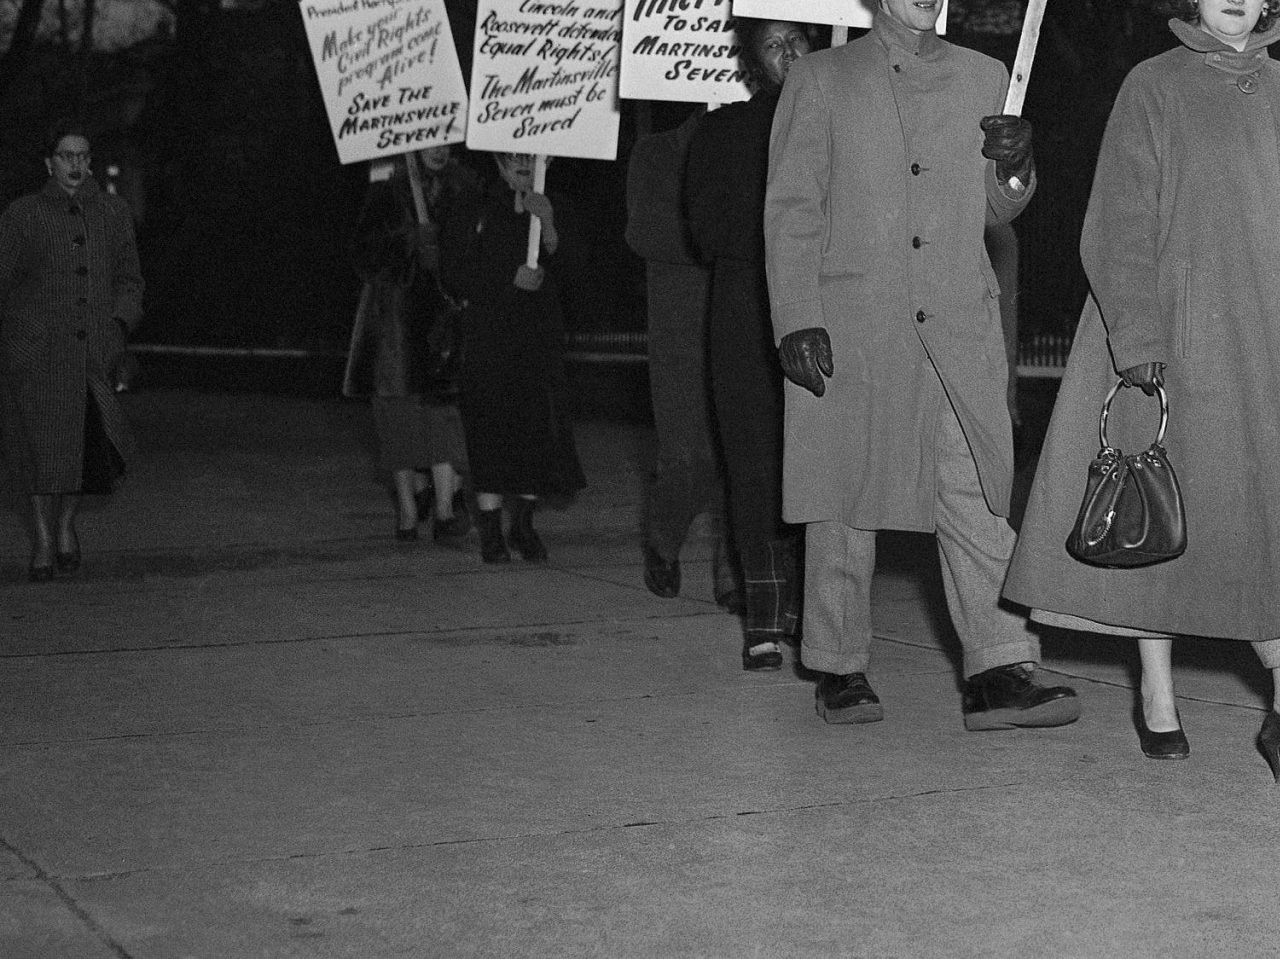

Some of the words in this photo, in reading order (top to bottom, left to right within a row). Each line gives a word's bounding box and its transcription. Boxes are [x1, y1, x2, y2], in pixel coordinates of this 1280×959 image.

[307, 0, 358, 19] President
[583, 4, 623, 21] and
[663, 15, 687, 31] TO
[691, 17, 738, 33] SAV
[322, 26, 363, 61] Make
[367, 9, 403, 39] your
[337, 39, 371, 73] Civil
[377, 6, 431, 49] Rights
[480, 10, 560, 36] Roosevelt
[558, 22, 619, 41] defende
[480, 35, 537, 59] Equal
[633, 35, 743, 59] MARTINSV
[376, 38, 438, 90] Alive!
[481, 75, 513, 100] The
[513, 60, 619, 94] Martinsville
[348, 92, 391, 115] SAVE
[399, 86, 432, 104] THE
[477, 101, 535, 124] Seven
[538, 85, 584, 112] must
[586, 82, 606, 102] be
[339, 102, 460, 139] MARTINSVILLE
[377, 117, 455, 149] SEVEN!
[513, 108, 582, 139] Saved
